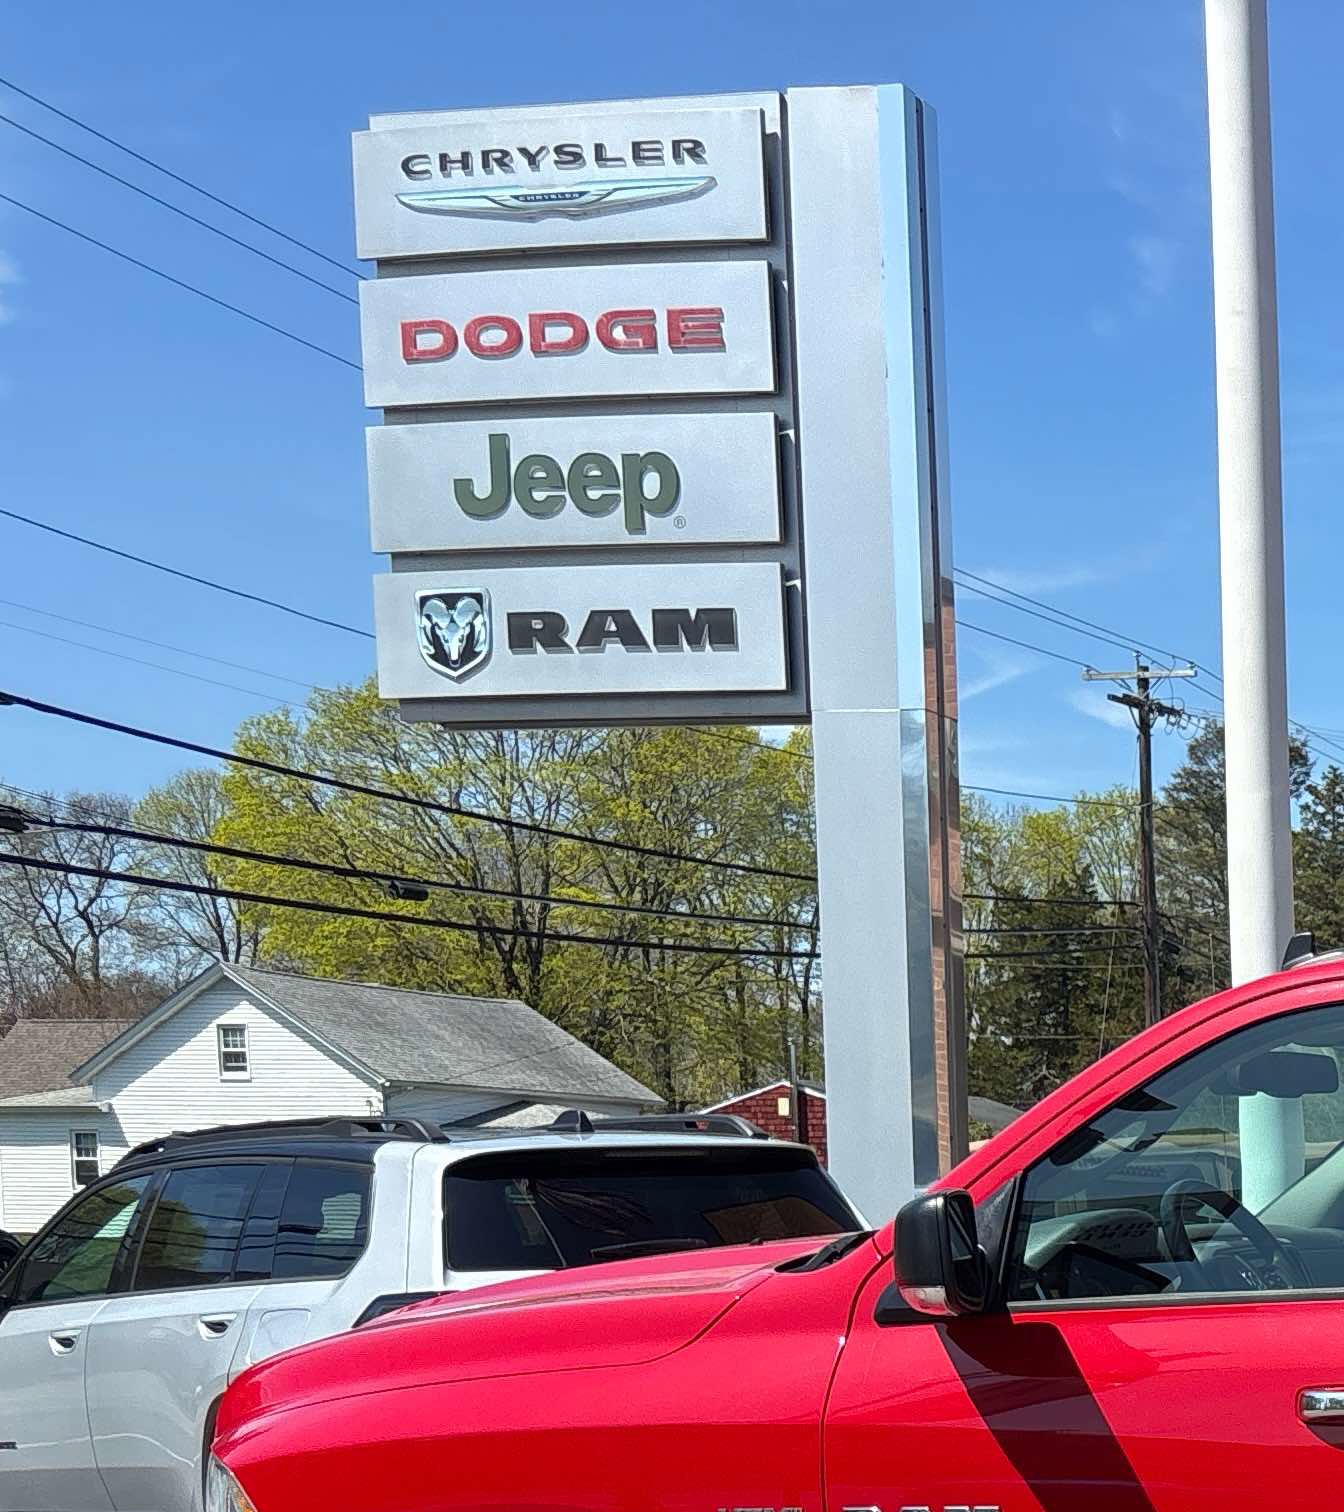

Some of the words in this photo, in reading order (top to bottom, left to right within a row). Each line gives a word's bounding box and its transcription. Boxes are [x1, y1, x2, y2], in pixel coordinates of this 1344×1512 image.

[401, 138, 709, 181] CHRYSLER
[400, 306, 727, 365] DODGE
[453, 433, 681, 535] Jeep
[506, 607, 739, 656] RAM
